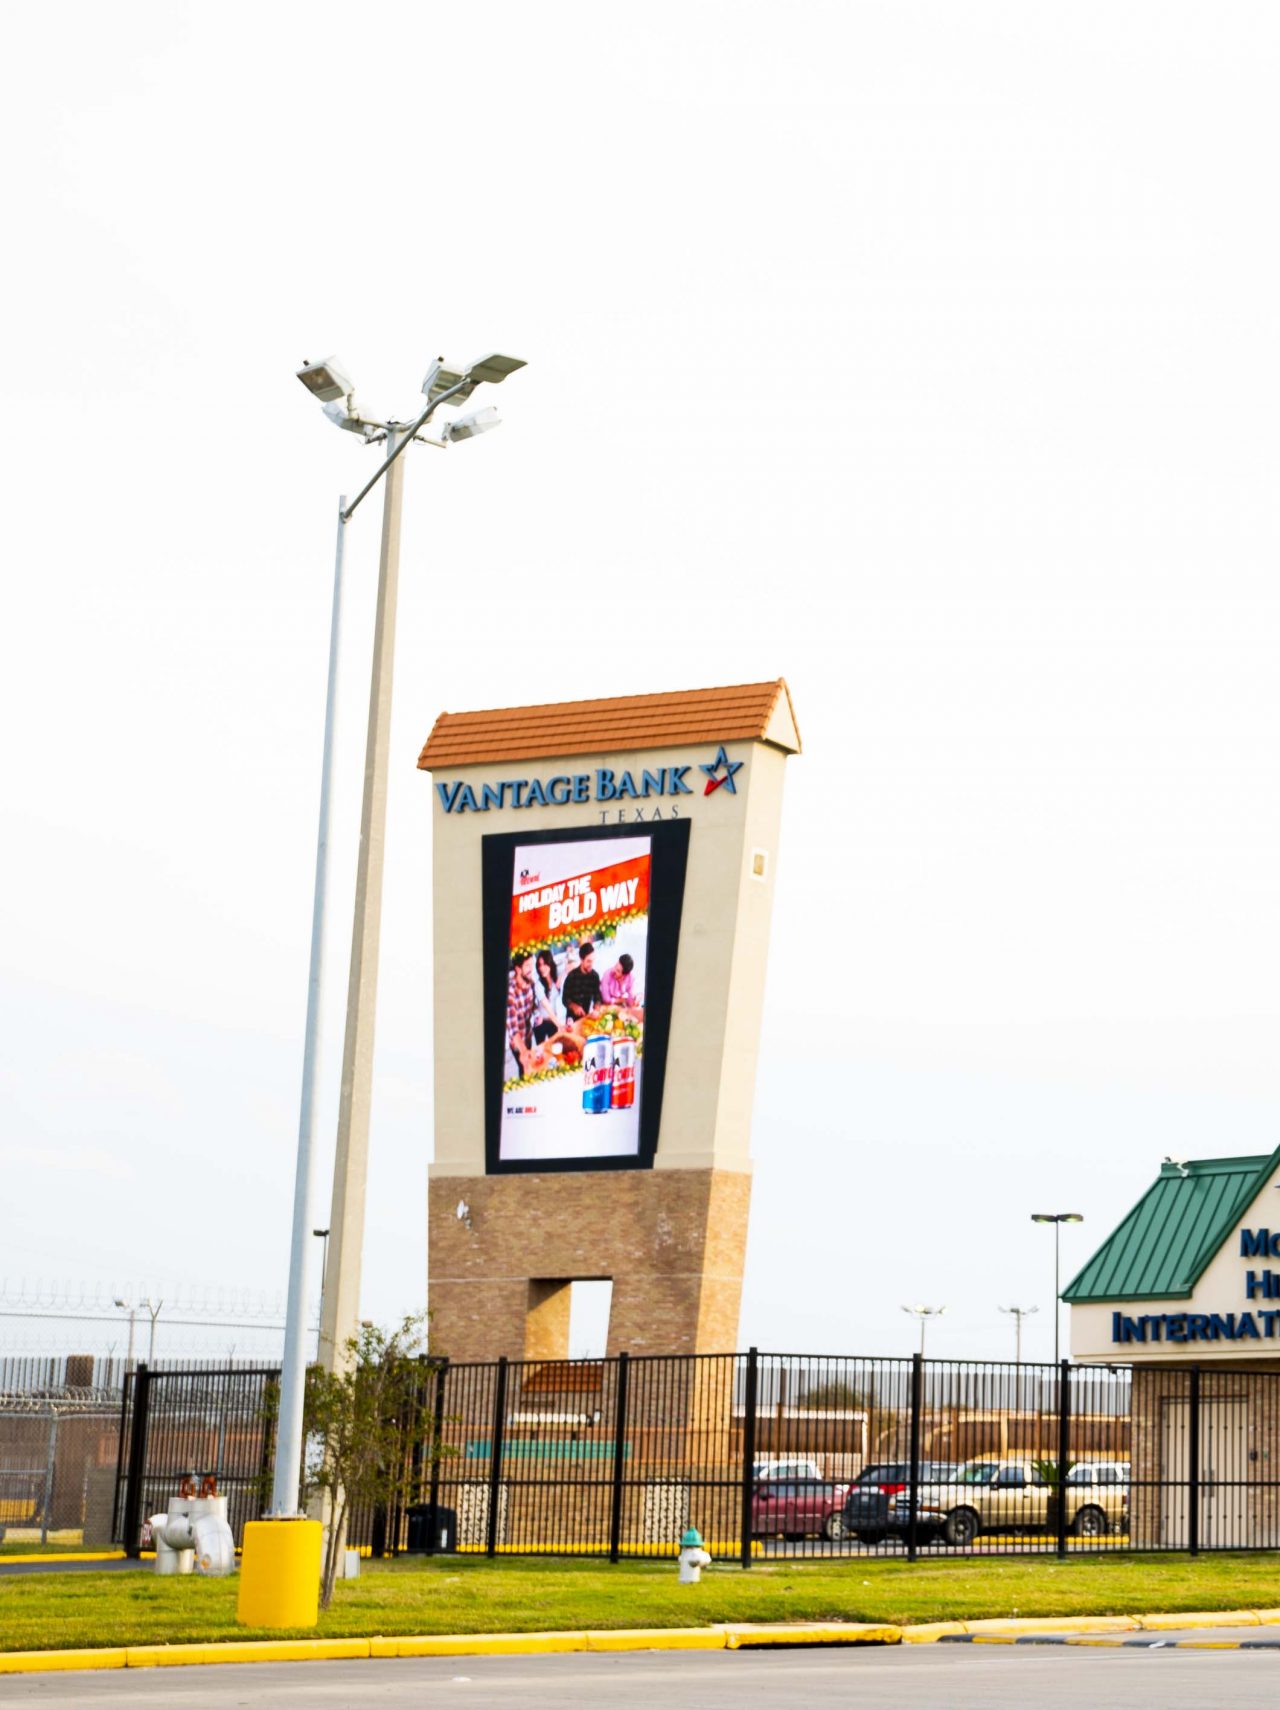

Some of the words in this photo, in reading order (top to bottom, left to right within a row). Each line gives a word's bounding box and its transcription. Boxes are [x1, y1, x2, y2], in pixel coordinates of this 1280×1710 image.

[435, 773, 590, 814] VANTAGE
[595, 765, 693, 801] BANK
[599, 805, 680, 825] TEXAS
[518, 882, 567, 914] HOLIDAY
[567, 875, 592, 898] THE
[548, 891, 598, 930] BOLD
[599, 877, 639, 914] WAY
